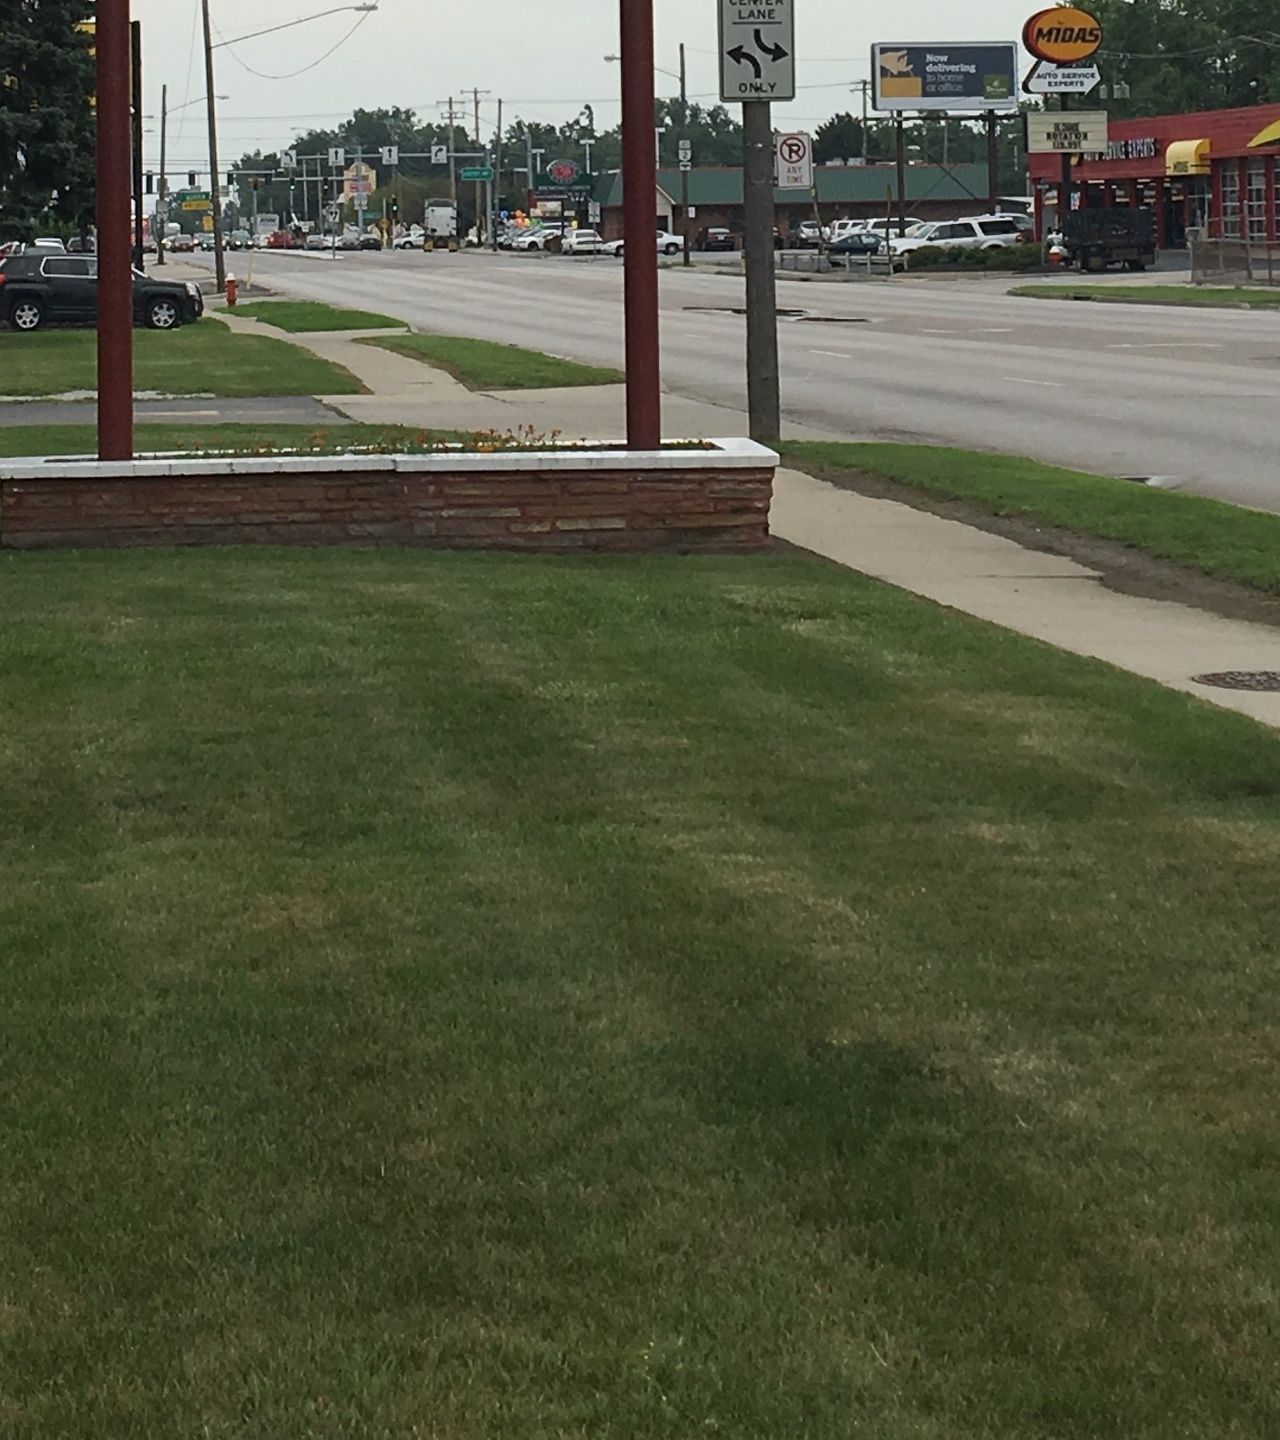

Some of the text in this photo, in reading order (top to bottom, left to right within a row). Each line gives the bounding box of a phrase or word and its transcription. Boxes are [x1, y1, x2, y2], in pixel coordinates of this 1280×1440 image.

[738, 9, 775, 20] LANE
[1036, 26, 1100, 44] MIDAS
[925, 54, 948, 63] Now
[925, 63, 976, 73] delivering
[738, 82, 777, 93] ONLY
[786, 166, 803, 174] ANY
[786, 175, 804, 185] TIME
